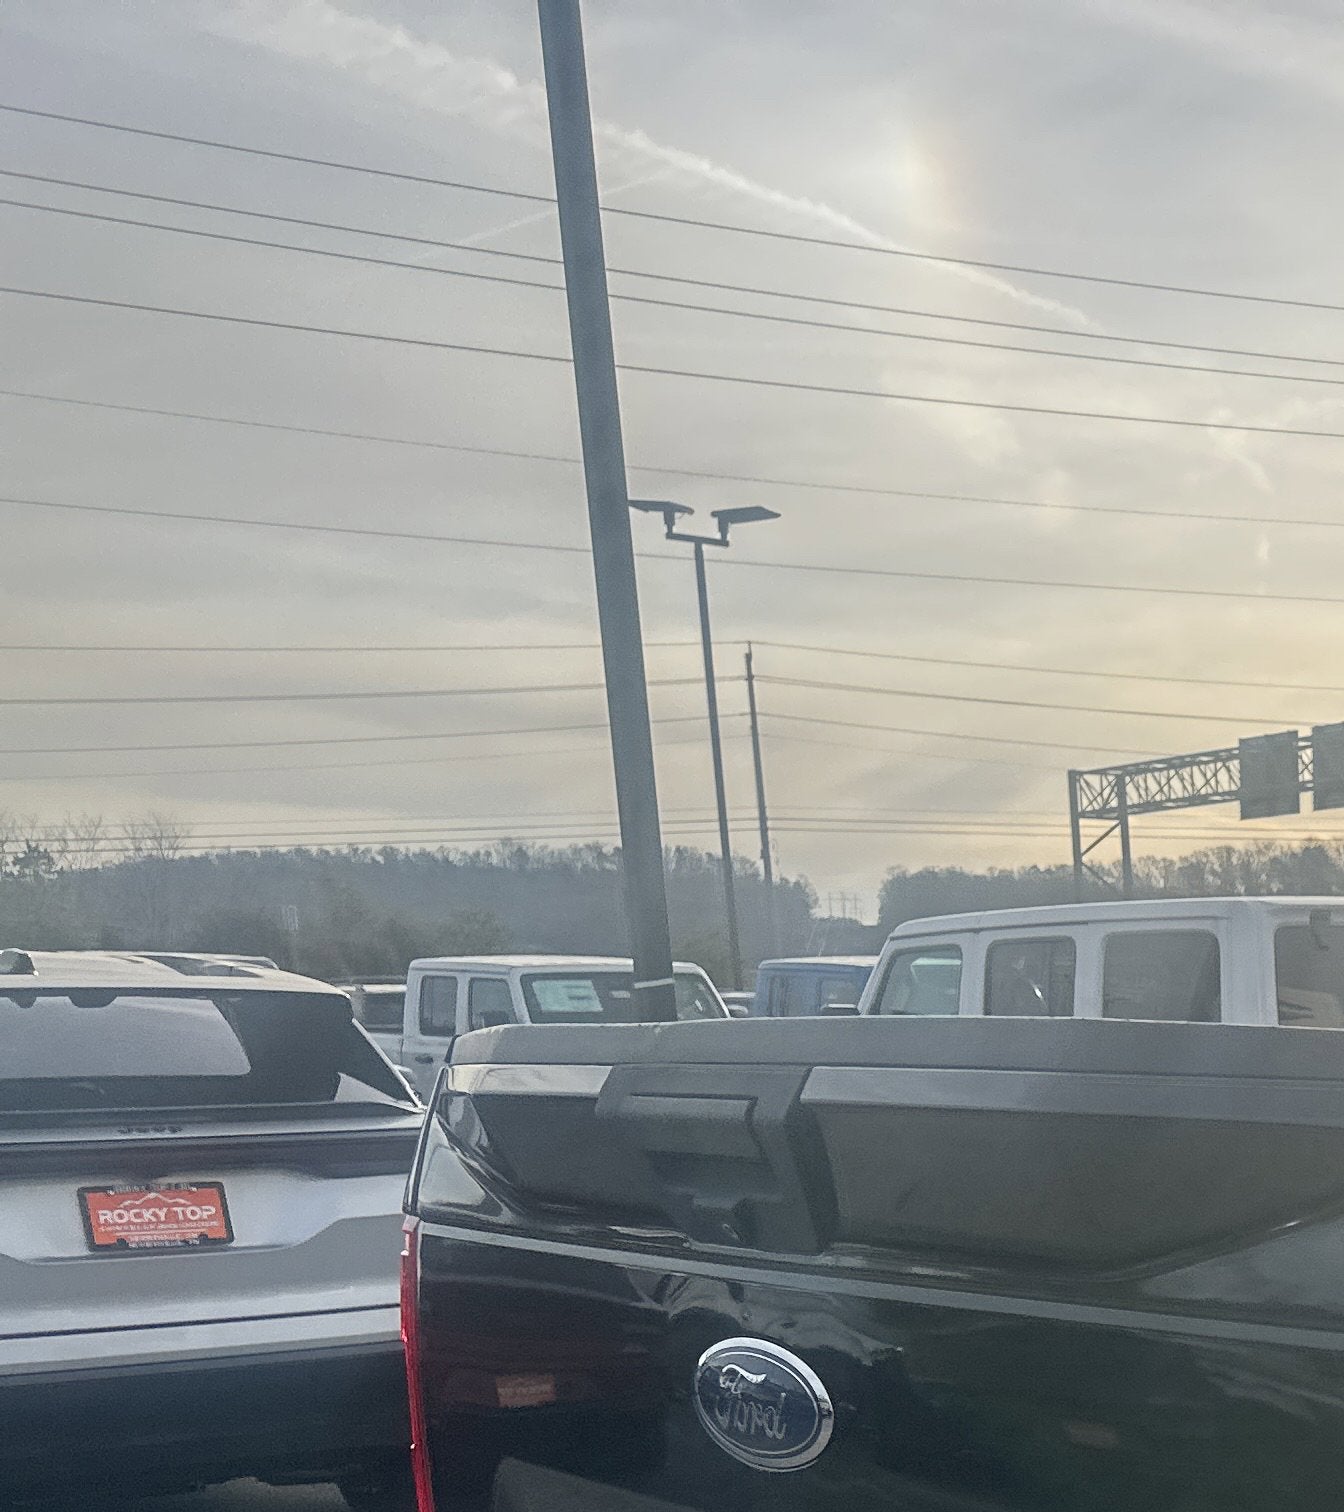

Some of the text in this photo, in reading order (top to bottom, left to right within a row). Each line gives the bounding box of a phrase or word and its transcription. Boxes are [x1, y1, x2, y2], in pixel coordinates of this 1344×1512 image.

[97, 1205, 216, 1225] ROCKY TOP
[715, 1363, 788, 1441] Ford
